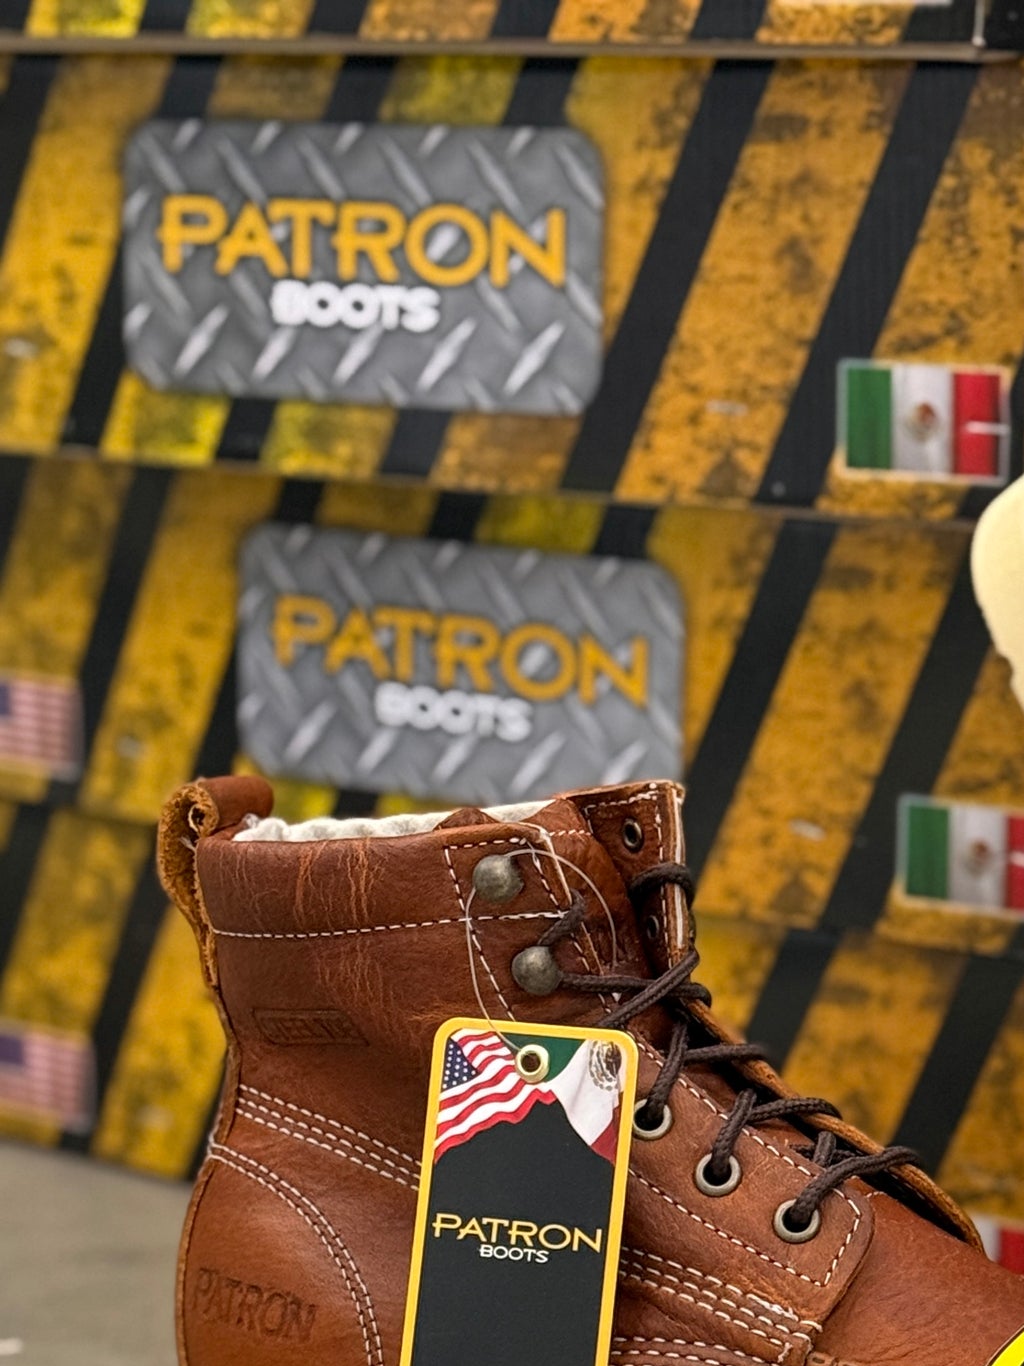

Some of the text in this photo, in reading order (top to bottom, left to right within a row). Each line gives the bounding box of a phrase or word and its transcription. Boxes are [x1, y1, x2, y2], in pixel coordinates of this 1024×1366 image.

[156, 194, 567, 288] PATRON
[271, 279, 441, 333] BOOTS
[272, 593, 650, 708] PATRON
[375, 681, 535, 743] BOOTS
[432, 1212, 603, 1253] PATRON
[479, 1244, 549, 1264] BOOTS
[192, 1267, 317, 1342] PATRON
